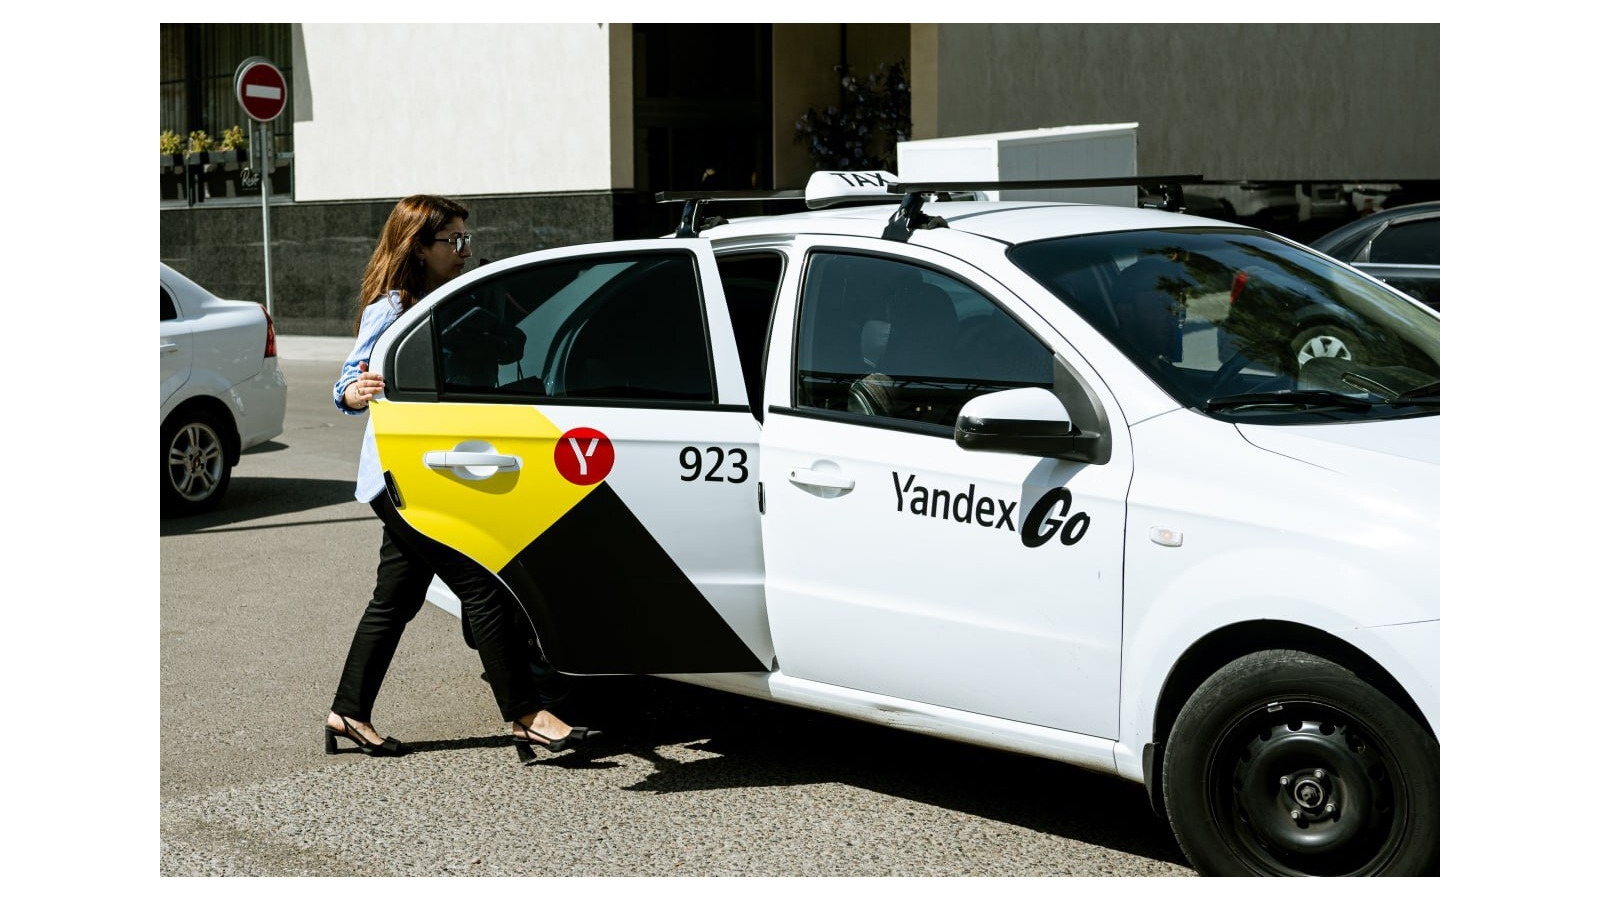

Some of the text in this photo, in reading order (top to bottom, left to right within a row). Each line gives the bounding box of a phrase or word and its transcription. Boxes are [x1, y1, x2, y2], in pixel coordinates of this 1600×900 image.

[568, 437, 600, 476] Y
[678, 446, 749, 484] 923
[892, 471, 1091, 548] Yandex Go
